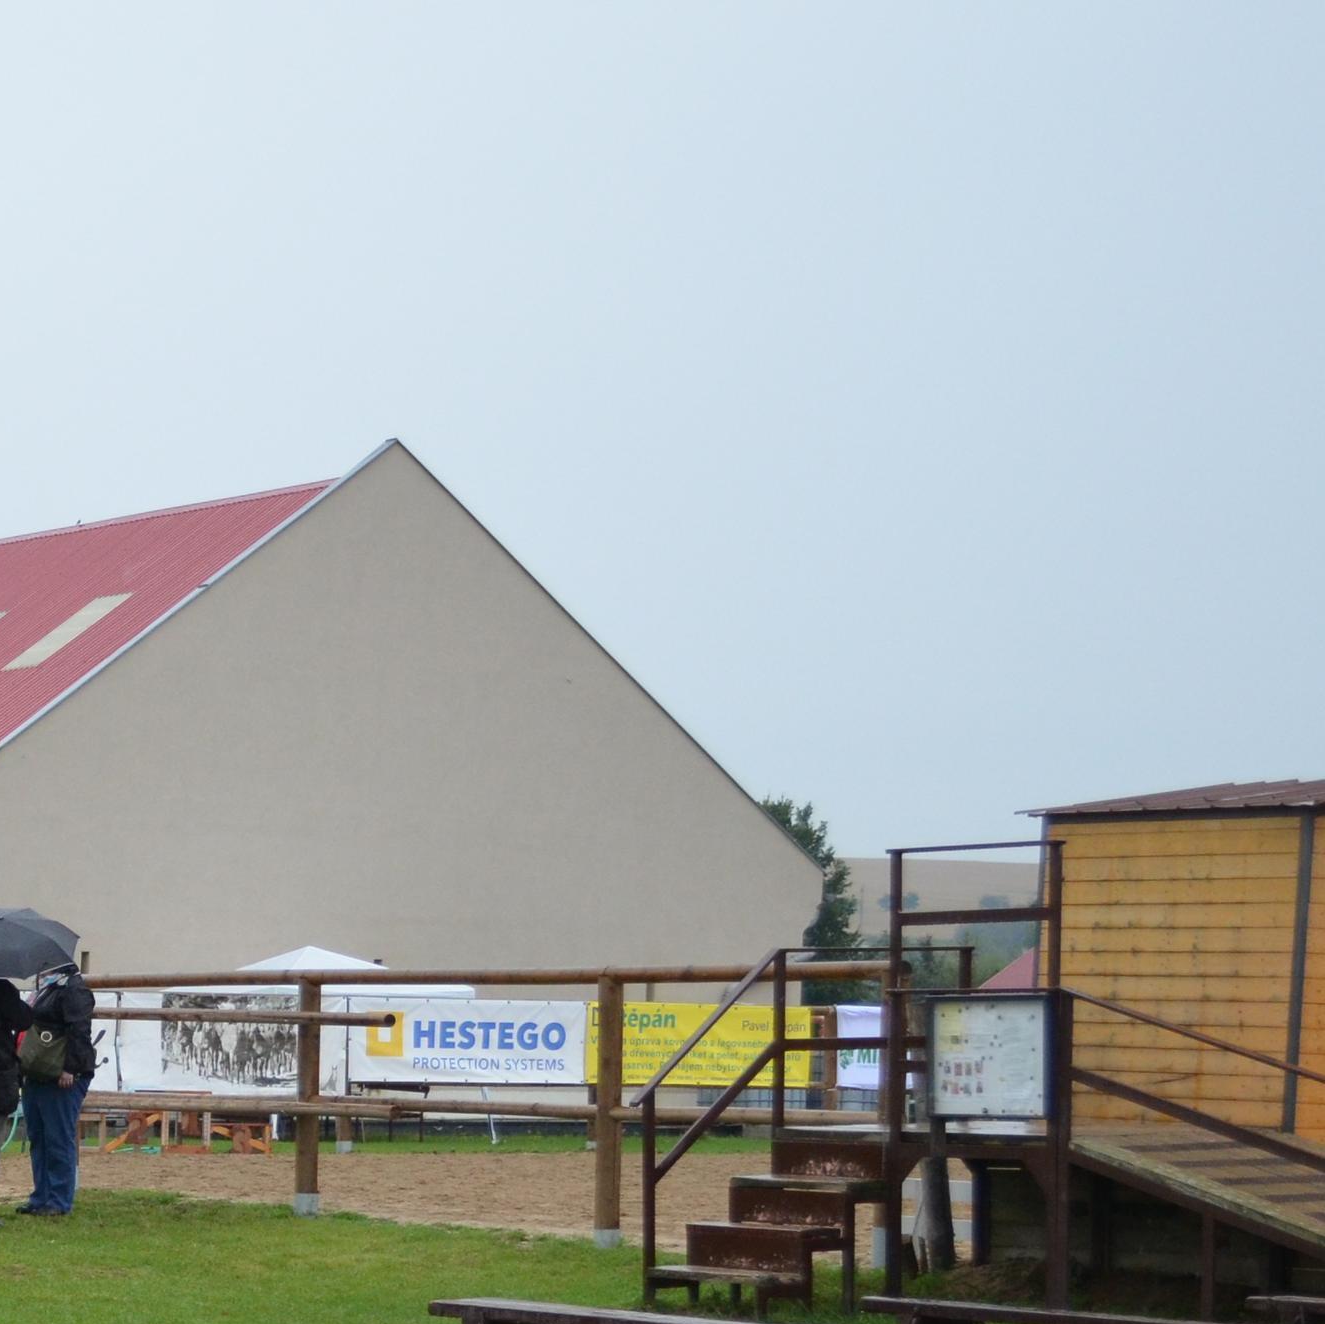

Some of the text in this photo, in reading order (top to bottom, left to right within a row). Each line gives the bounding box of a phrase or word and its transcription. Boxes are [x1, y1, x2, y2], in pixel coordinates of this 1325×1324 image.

[742, 1020, 770, 1032] Pavel
[413, 1020, 567, 1051] HESTEGO
[412, 1057, 565, 1071] PROTECTION SYSTEMS
